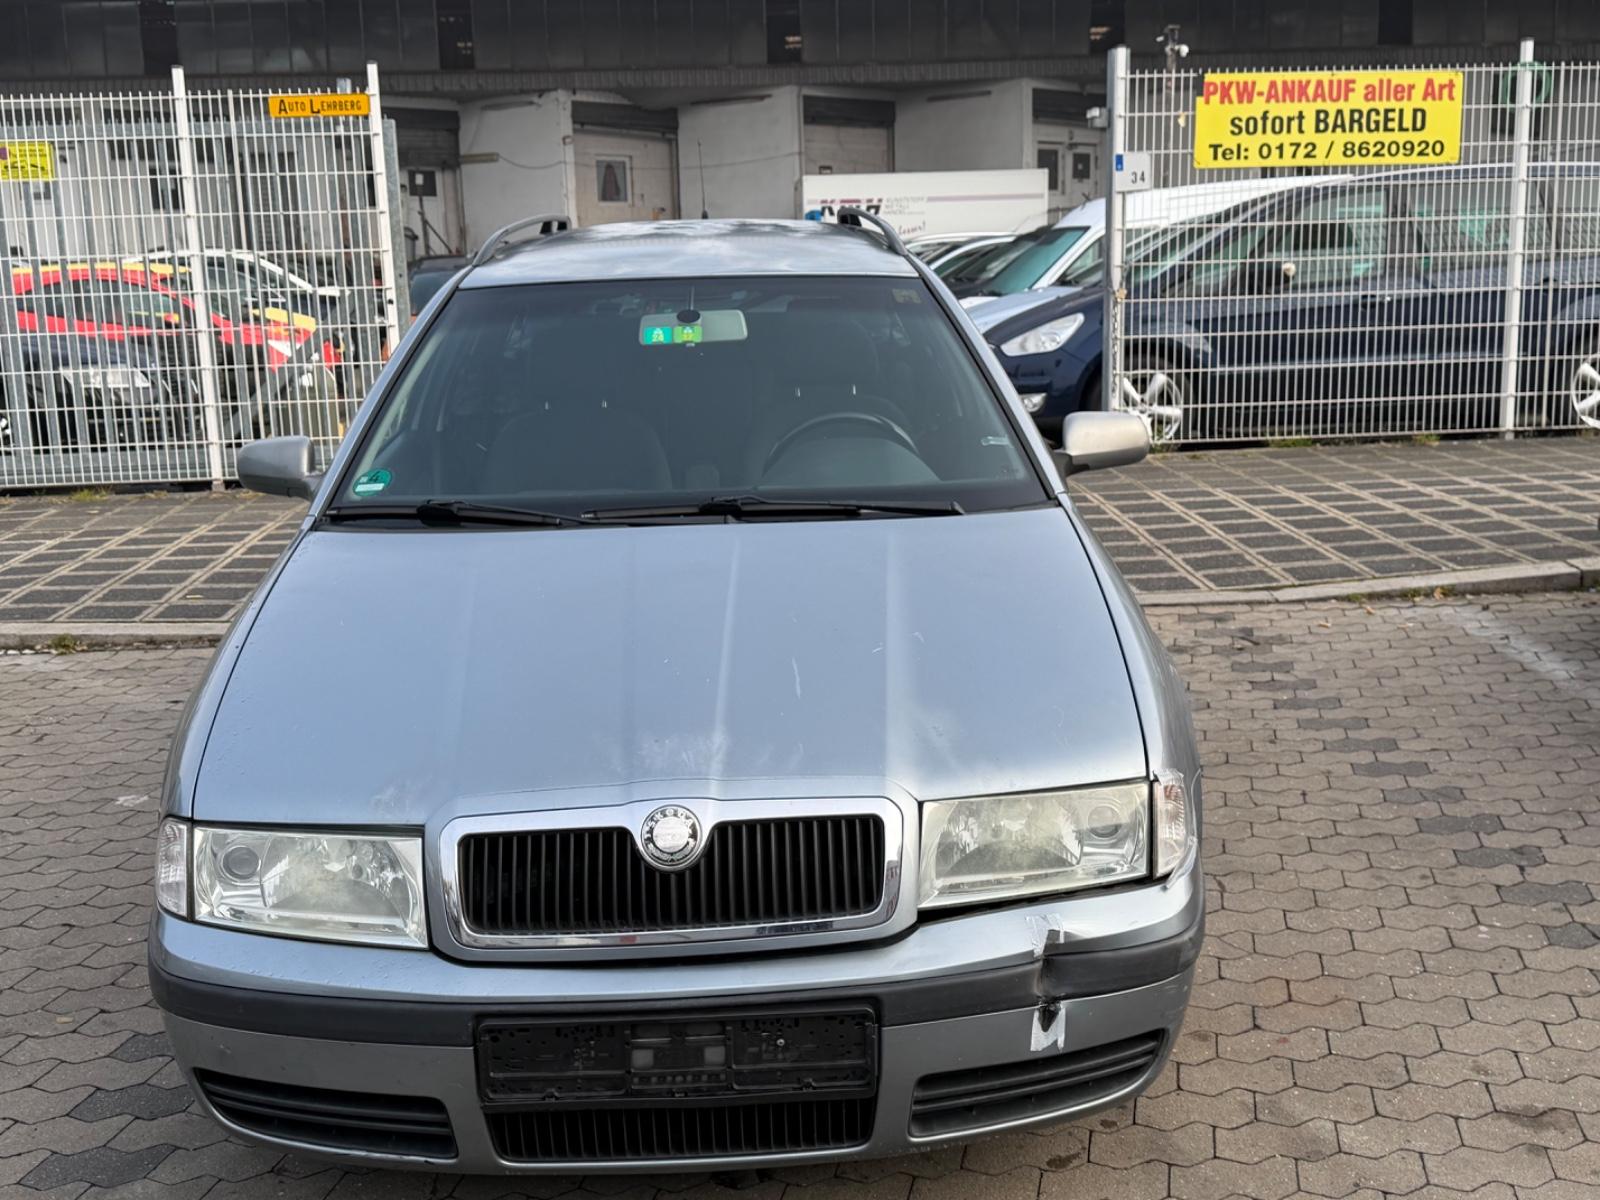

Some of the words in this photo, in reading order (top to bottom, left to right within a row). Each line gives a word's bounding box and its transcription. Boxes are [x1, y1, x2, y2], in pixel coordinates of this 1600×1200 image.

[1203, 79, 1356, 105] PKW-ANKAUF
[1363, 79, 1415, 101] aller
[1422, 77, 1455, 101] Art
[1230, 110, 1305, 135] sofort
[1314, 108, 1427, 134] BARGELD
[1208, 143, 1249, 160] Tel:
[1258, 142, 1317, 159] 0172
[1325, 141, 1334, 159] /
[1342, 140, 1445, 159] 8620920
[1131, 171, 1145, 184] 34
